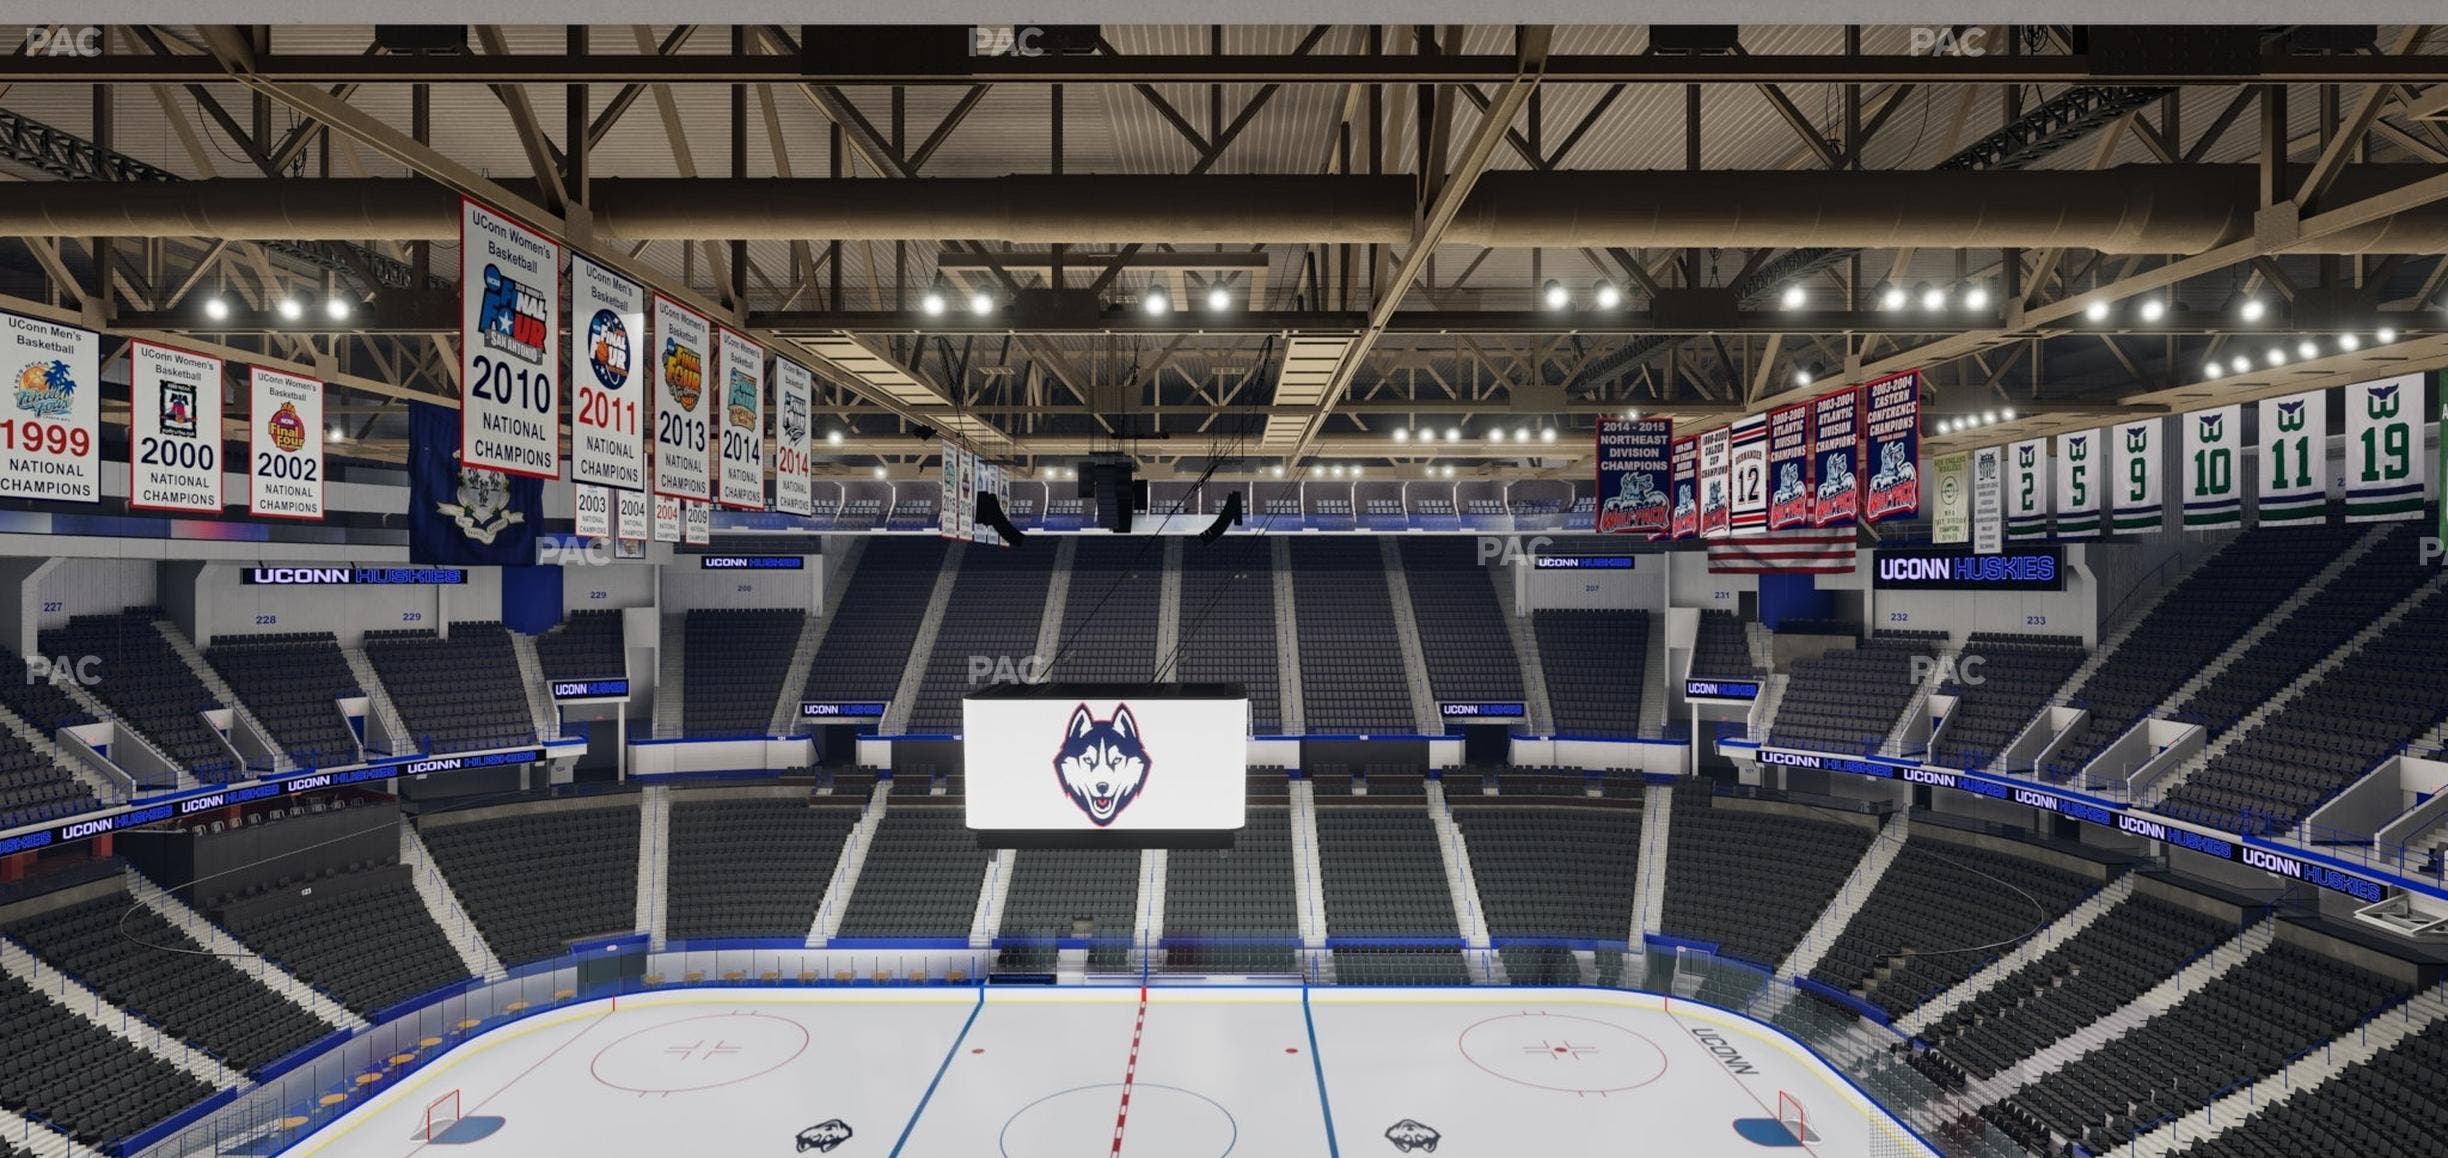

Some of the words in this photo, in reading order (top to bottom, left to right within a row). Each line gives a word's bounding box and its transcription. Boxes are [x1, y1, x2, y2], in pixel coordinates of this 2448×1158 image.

[473, 210, 507, 239] UConn
[509, 228, 551, 260] Women's
[488, 240, 538, 274] Basketball
[586, 264, 611, 286] UConn
[612, 277, 633, 297] Men's
[591, 286, 629, 312] Basketball
[9, 317, 47, 334] UConn
[50, 326, 82, 341] Men's
[17, 334, 74, 354] Basketball
[491, 331, 507, 348] SAN
[141, 347, 173, 362] UConn
[174, 354, 214, 371] Women's
[155, 364, 202, 381] Basketball
[258, 373, 283, 385] UConn
[285, 378, 317, 392] Women's
[269, 387, 307, 401] Basketball
[472, 355, 551, 414] 2010
[1872, 374, 1913, 397] 2003-2004
[1817, 392, 1855, 413] 2003-2004
[1874, 389, 1910, 409] EASTERN
[578, 386, 635, 436] 2011
[1818, 406, 1853, 426] ATLANTIC
[1867, 401, 1917, 424] CONFERENCE
[268, 421, 299, 437] Final
[483, 412, 546, 441] NATIONAL
[660, 410, 705, 452] 2013
[1603, 422, 1630, 432] 2014
[1639, 422, 1666, 432] 2015
[1773, 420, 1804, 438] ATLANTIC
[1820, 420, 1852, 439] DIVISION
[1869, 416, 1914, 437] CHAMPIONS
[0, 419, 90, 457] 1999
[586, 436, 635, 459] NATIONAL
[723, 429, 760, 466] 2014
[1600, 435, 1668, 445] NORTHEAST
[1775, 432, 1802, 449] DIVISION
[1815, 434, 1857, 453] CHAMPIONS
[141, 437, 214, 471] 2000
[475, 439, 552, 468] CHAMPIONS
[780, 446, 809, 478] 2014
[1609, 447, 1660, 458] DIVISION
[1771, 445, 1806, 463] CHAMPIONS
[2361, 422, 2410, 482] 19
[9, 458, 84, 477] NATIONAL
[258, 452, 317, 481] 2002
[581, 459, 639, 483] CHAMPIONS
[665, 453, 703, 473] NATIONAL
[1600, 461, 1669, 471] CHAMPIONS
[2194, 448, 2231, 496] 10
[2272, 435, 2312, 490] 11
[150, 472, 209, 488] NATIONAL
[661, 474, 706, 494] CHAMPIONS
[728, 468, 758, 485] NATIONAL
[1738, 465, 1760, 504] 12
[2072, 465, 2086, 507] 5
[2130, 457, 2146, 502] 9
[0, 478, 91, 496] CHAMPIONS
[265, 483, 313, 497] NATIONAL
[725, 486, 760, 503] CHAMPIONS
[782, 480, 807, 495] NATIONAL
[2022, 472, 2034, 511] 2
[143, 489, 215, 506] CHAMPIONS
[260, 499, 318, 513] CHAMPIONS
[579, 494, 606, 513] 2003
[621, 499, 645, 517] 2004
[656, 504, 678, 520] 2004
[687, 508, 707, 524] 2009
[705, 558, 747, 567] UCONN
[1539, 558, 1578, 567] UCONN
[1880, 557, 1950, 581] UCONN
[1954, 555, 2055, 581] HUSKIES
[255, 568, 349, 584] UCONN
[356, 568, 461, 584] HUSKIES
[44, 602, 63, 612] 227
[402, 613, 422, 621] 229
[1890, 612, 1908, 622] 232
[256, 615, 277, 625] 228
[2026, 616, 2046, 626] 233
[555, 683, 588, 696] UCONN
[1688, 682, 1718, 694] UCONN
[804, 704, 839, 714] UCONN
[1443, 704, 1478, 714] UCONN
[408, 758, 461, 774] UCONN
[464, 751, 536, 767] HUSKIES
[1761, 751, 1820, 768] UCONN
[1823, 759, 1894, 778] HUSKIES
[288, 775, 330, 792] UCONN
[332, 766, 398, 784] HUSKIES
[1903, 768, 1955, 787] UCONN
[1957, 779, 2008, 798] HUSKIES
[182, 794, 224, 814] UCONN
[225, 784, 280, 805] HUSKIES
[2015, 789, 2057, 811] UCONN
[2059, 800, 2111, 825] HUSKIES
[62, 818, 112, 840] UCONN
[115, 806, 173, 828] HUSKIES
[2119, 814, 2165, 840] UCONN
[2167, 827, 2232, 859] HUSKIES
[2242, 847, 2300, 877] UCONN
[2304, 864, 2381, 901] HUSKIES
[1692, 1028, 1760, 1075] UCONN
